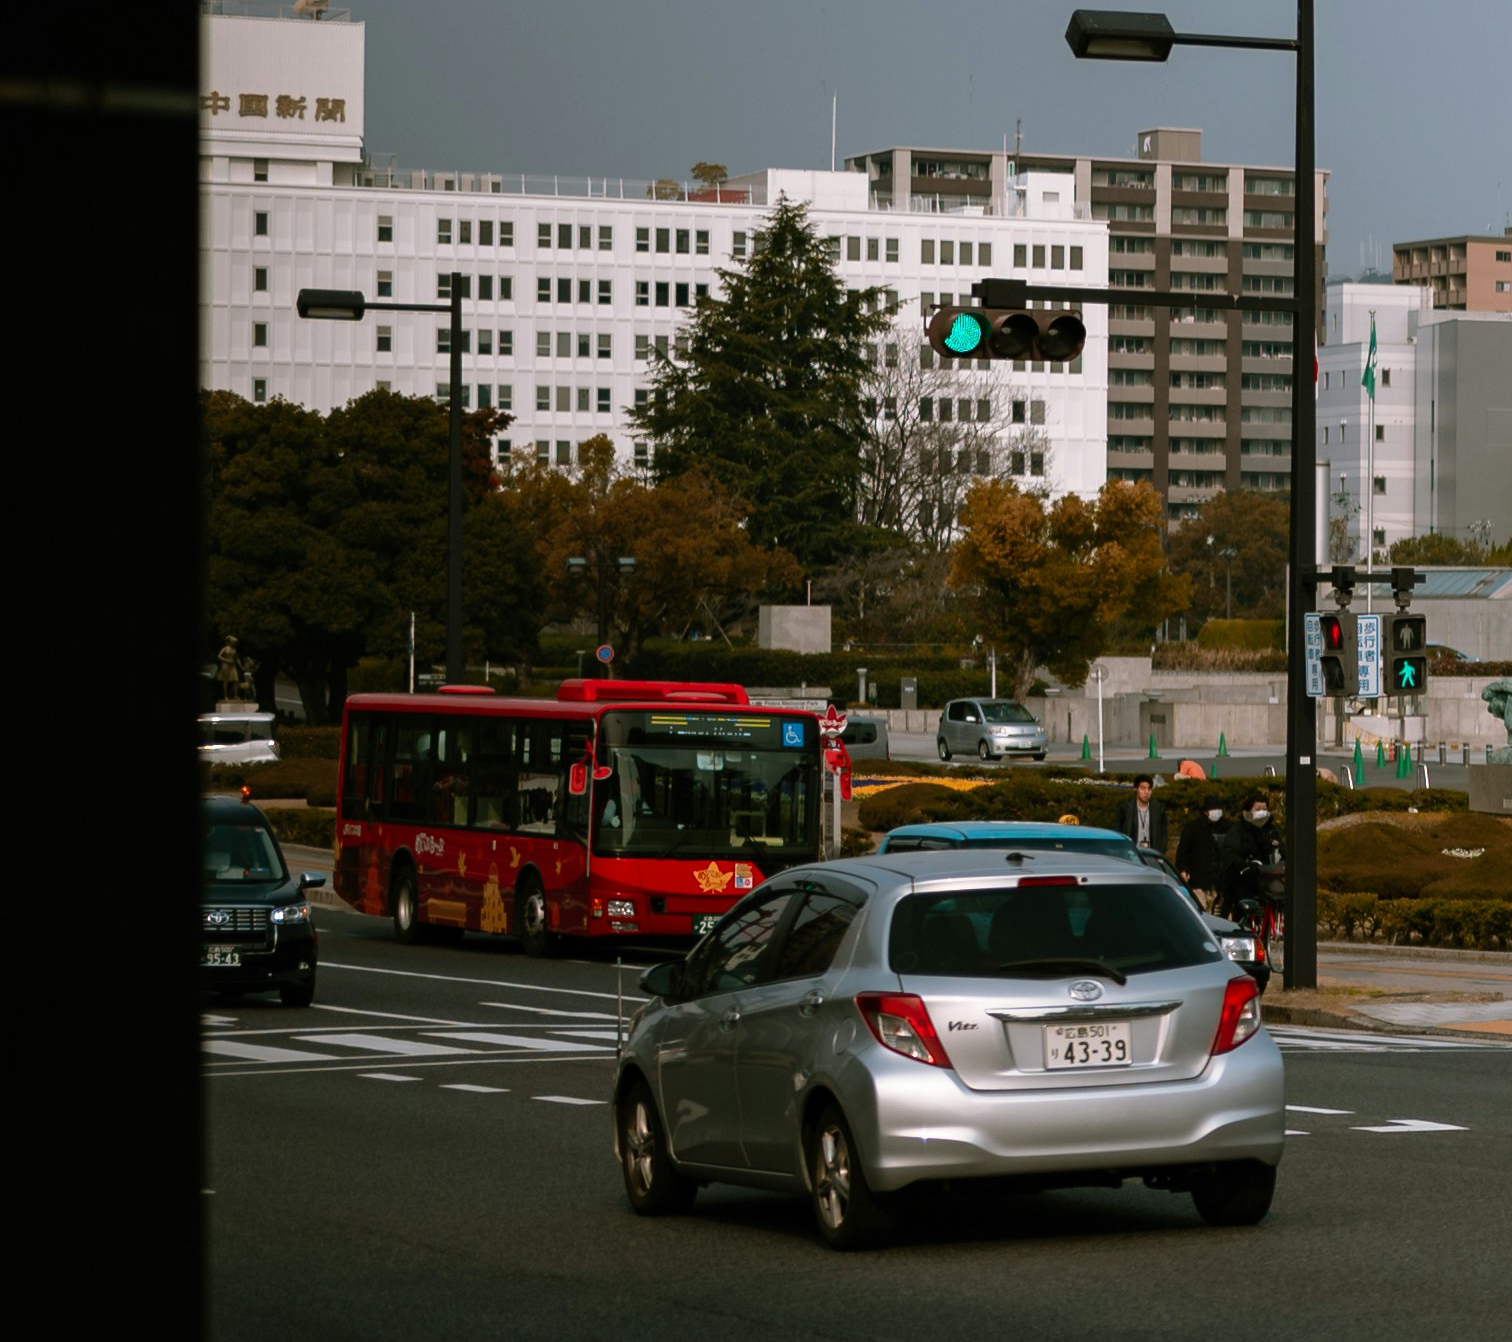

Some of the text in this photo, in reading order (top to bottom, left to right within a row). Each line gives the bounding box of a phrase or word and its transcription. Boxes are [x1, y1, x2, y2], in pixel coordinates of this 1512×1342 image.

[1364, 622, 1375, 662] 歩行者
[948, 1021, 978, 1032] Vitz
[1064, 1039, 1127, 1064] 43-39
